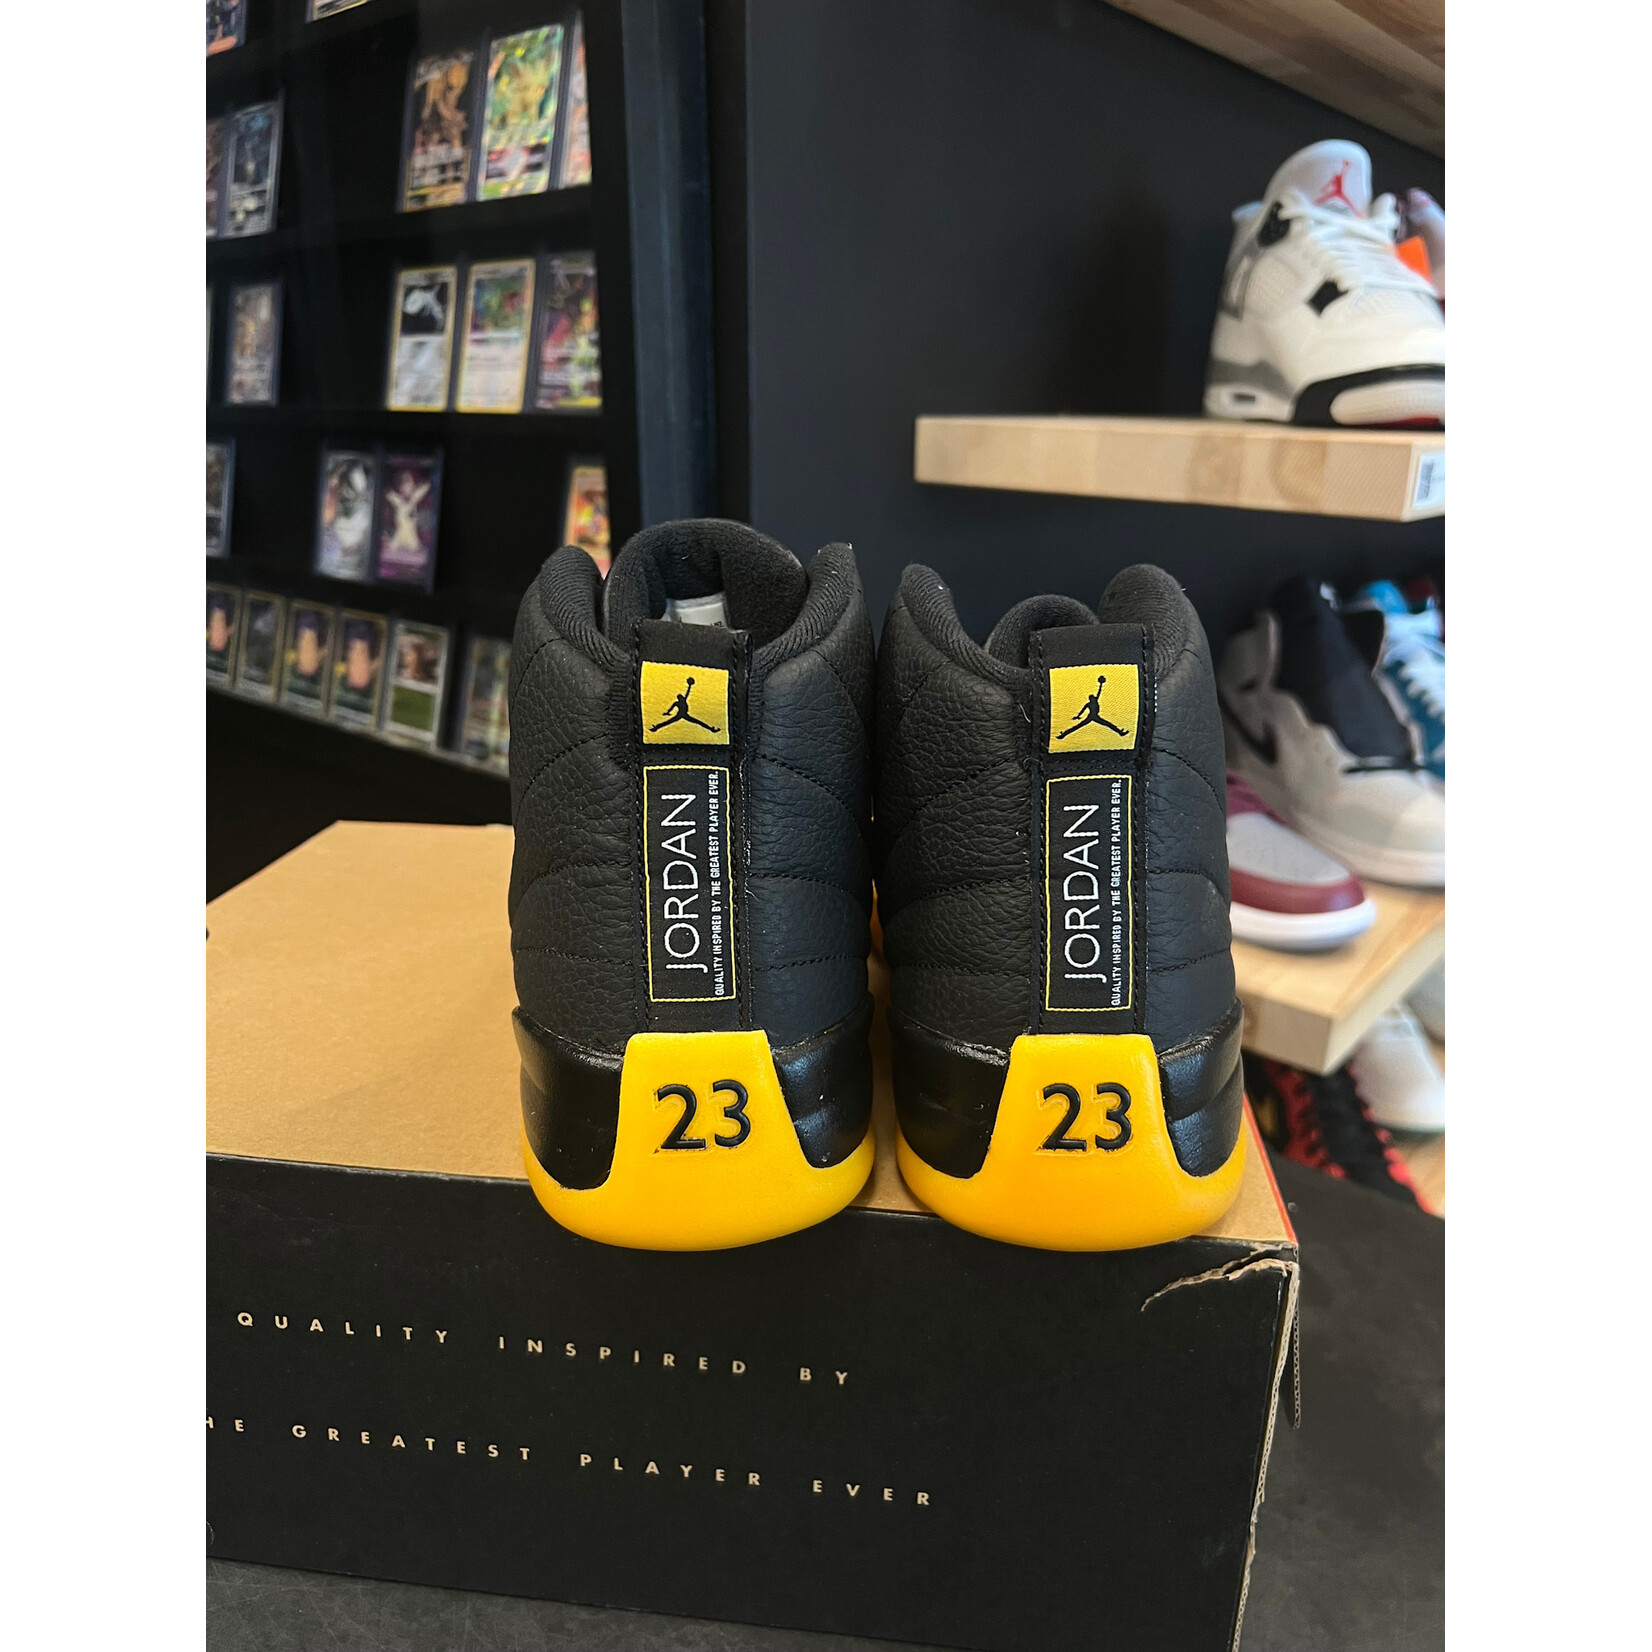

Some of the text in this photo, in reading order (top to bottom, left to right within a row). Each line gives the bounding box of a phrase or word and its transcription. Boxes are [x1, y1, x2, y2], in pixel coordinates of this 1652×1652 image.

[661, 794, 709, 974] JORDAN
[708, 770, 725, 996] QUALITY INSPIRED BY THE GREATEST PLAYER EVER.
[1063, 804, 1107, 983] JORDAN
[1110, 778, 1122, 1006] QUALITY INSPIRED BY THE GREATEST PLAYER EVER.
[655, 1078, 752, 1150] 23
[1040, 1082, 1133, 1152] 23
[237, 1311, 848, 1386] QUALITY INSPIRED BY
[291, 1424, 531, 1461] GREATEST
[579, 1453, 761, 1486] PLAYER
[812, 1479, 930, 1506] EVER
